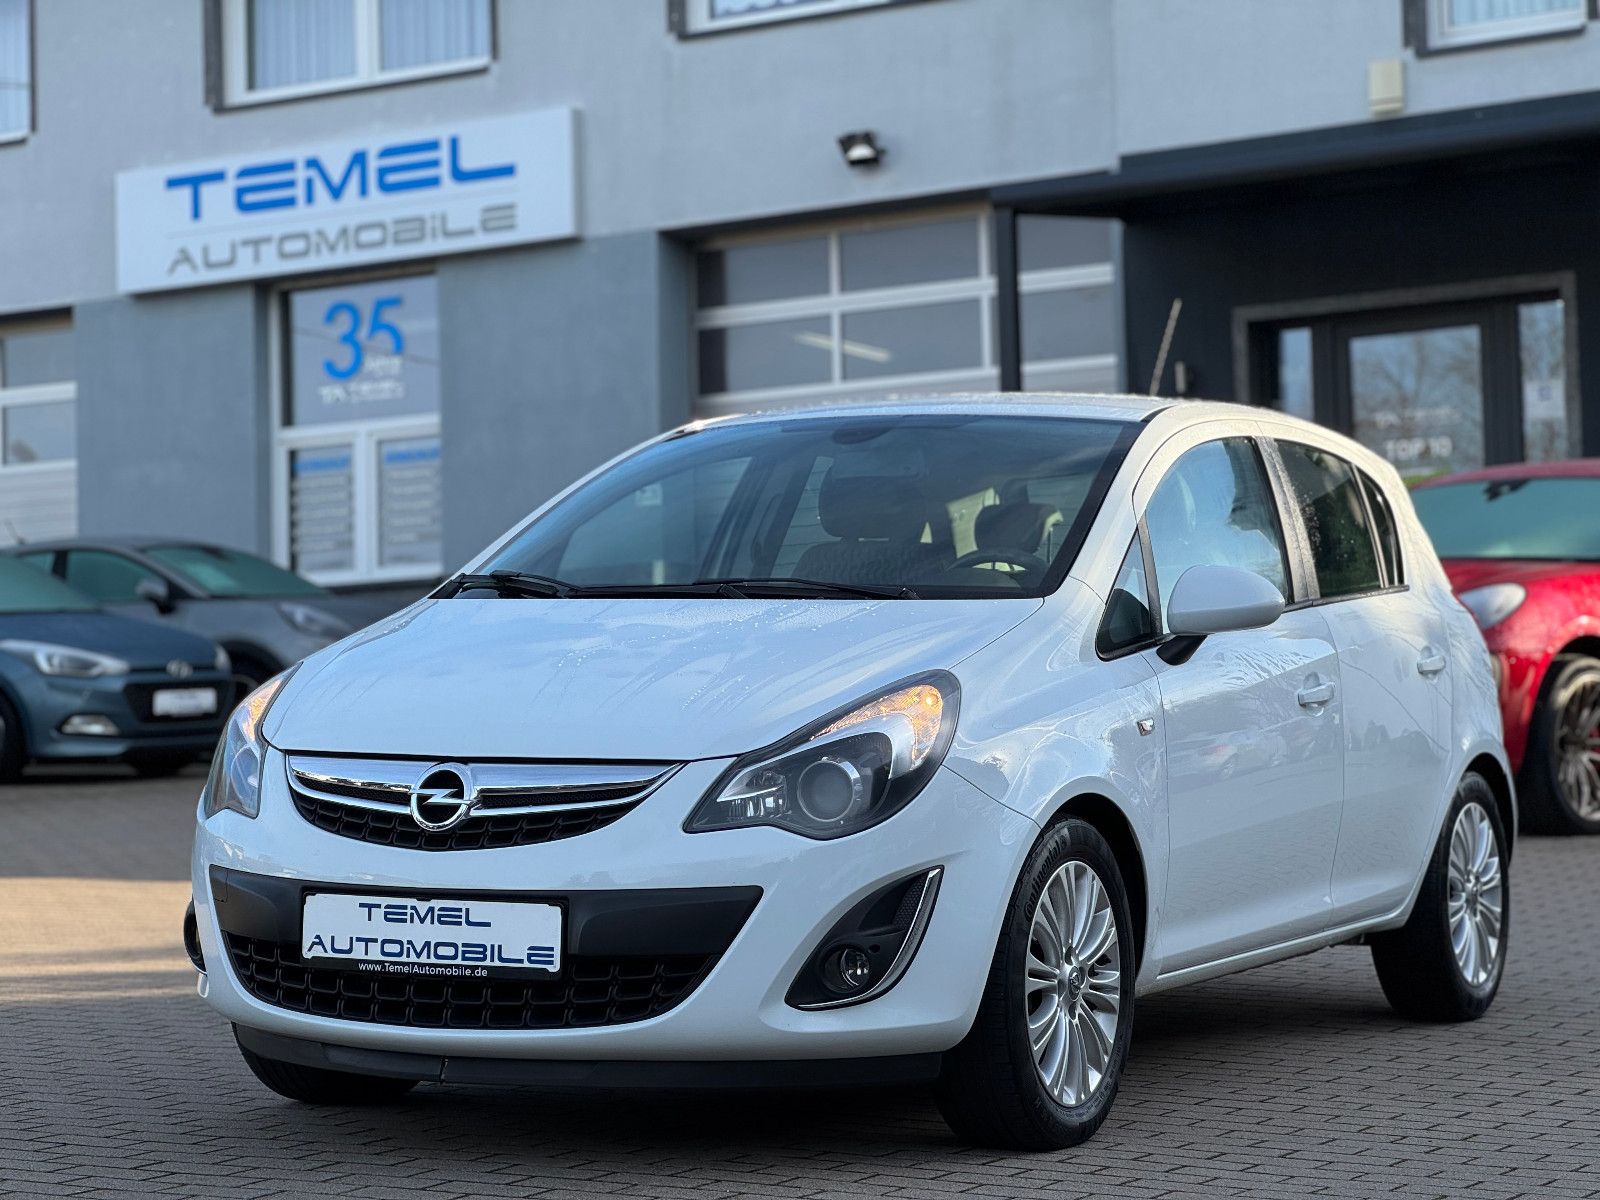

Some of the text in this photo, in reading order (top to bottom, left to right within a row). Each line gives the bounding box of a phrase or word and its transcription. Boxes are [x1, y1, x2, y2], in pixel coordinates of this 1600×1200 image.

[165, 135, 517, 221] TEMEL
[323, 297, 404, 380] 35
[1024, 839, 1061, 922] Continental
[358, 902, 491, 927] TEMEL
[306, 934, 555, 966] AUTOMOBILE
[358, 961, 489, 977] www.TemelAutomobile.de
